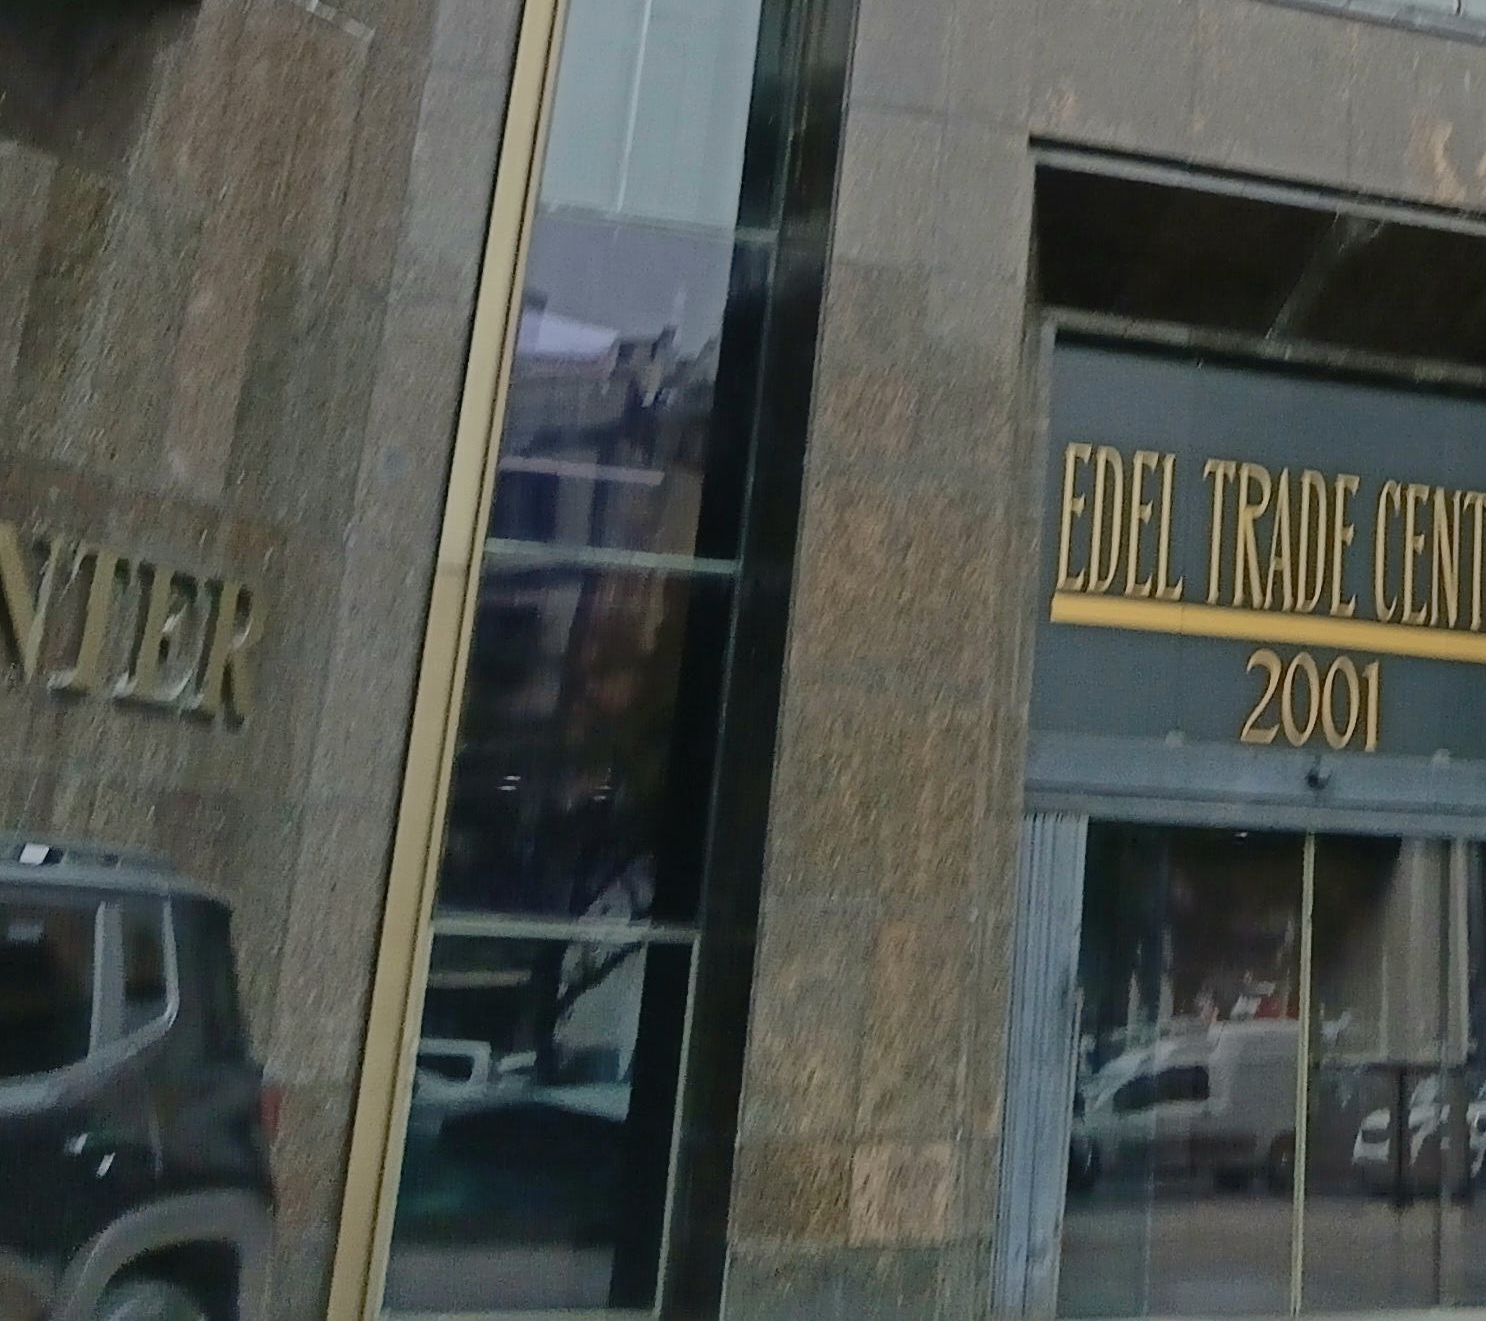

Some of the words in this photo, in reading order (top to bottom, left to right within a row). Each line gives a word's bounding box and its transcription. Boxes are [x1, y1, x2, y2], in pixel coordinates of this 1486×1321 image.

[1056, 442, 1184, 600] EDEL
[1202, 459, 1361, 617] TRADE
[1239, 648, 1381, 752] 2001
